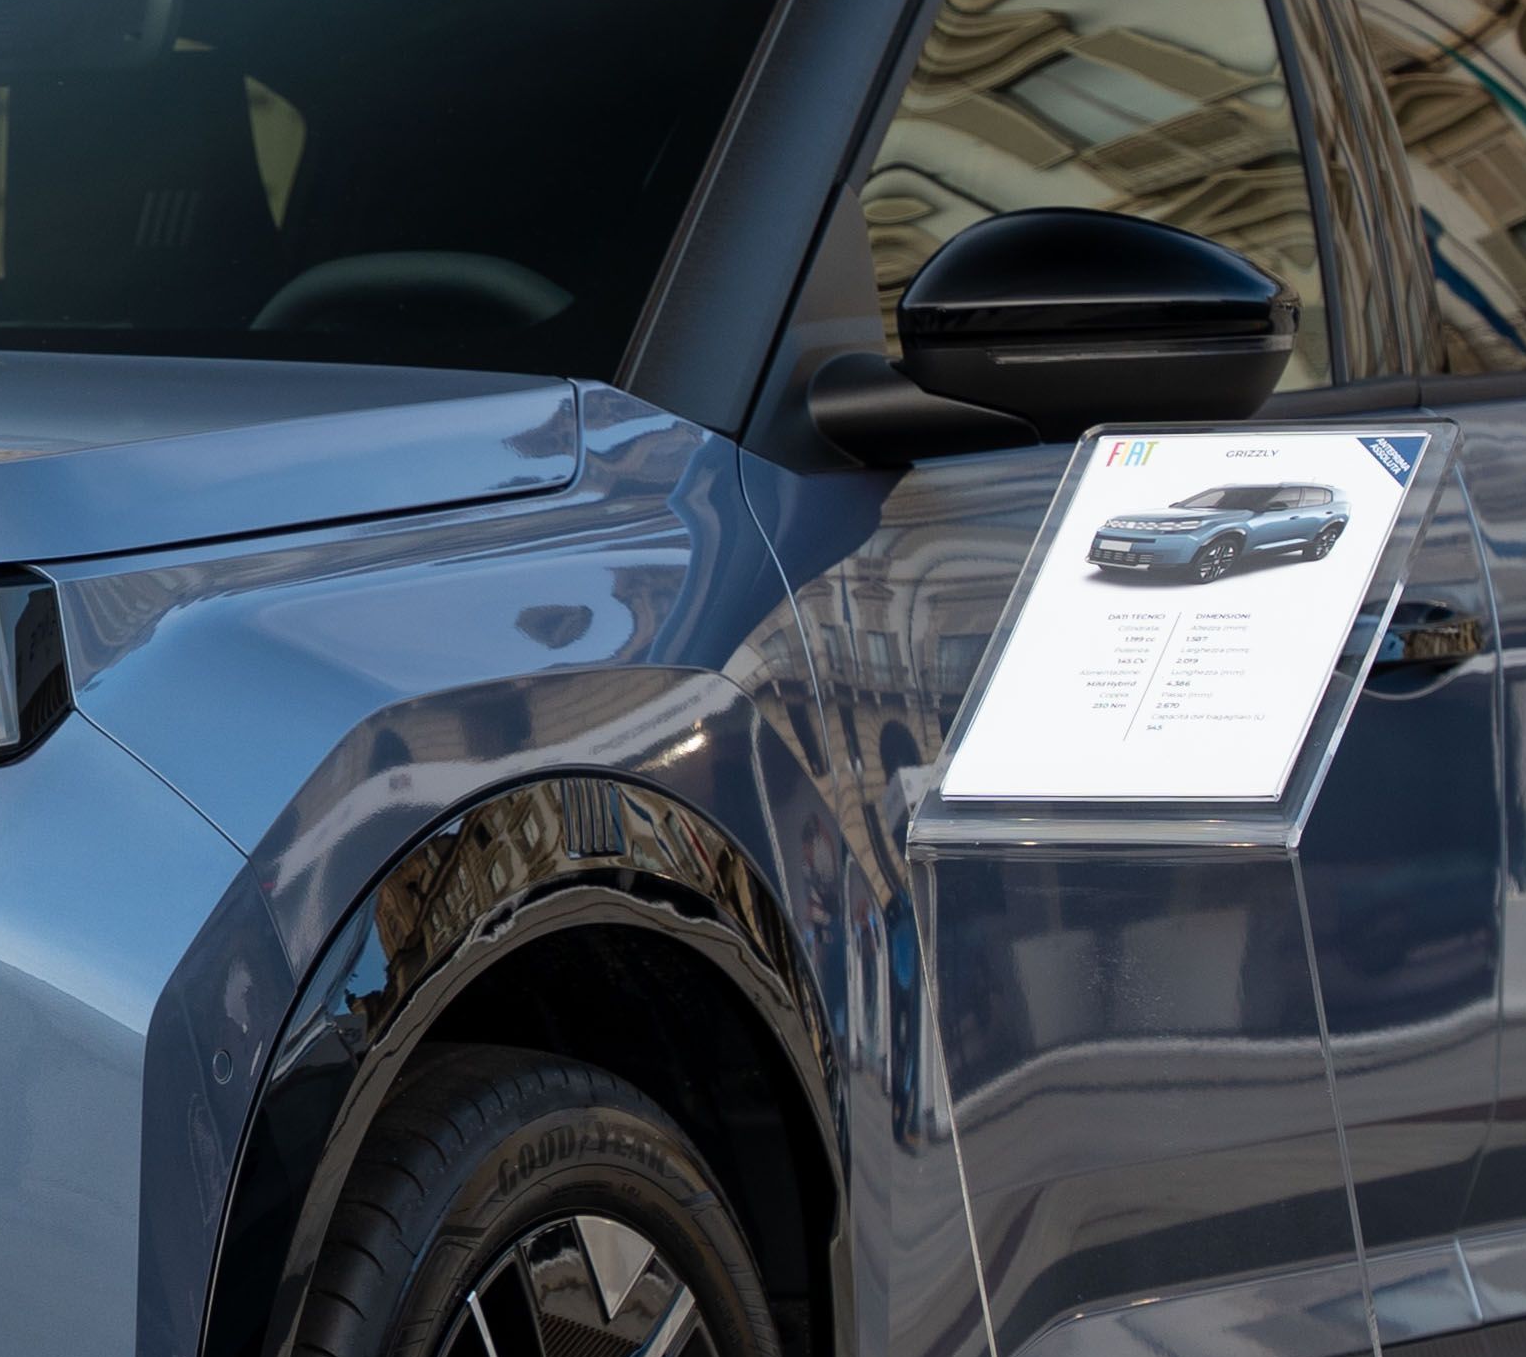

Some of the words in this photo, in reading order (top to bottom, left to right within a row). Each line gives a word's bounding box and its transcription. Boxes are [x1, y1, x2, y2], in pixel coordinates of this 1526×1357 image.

[1106, 441, 1159, 468] FIAT
[1225, 448, 1280, 459] GRIZZLY
[1369, 443, 1402, 475] ASSOLUTA
[1376, 438, 1411, 472] ANTEPRIMA
[1108, 613, 1129, 621] DATI
[497, 1120, 676, 1196] GOODYEAR
